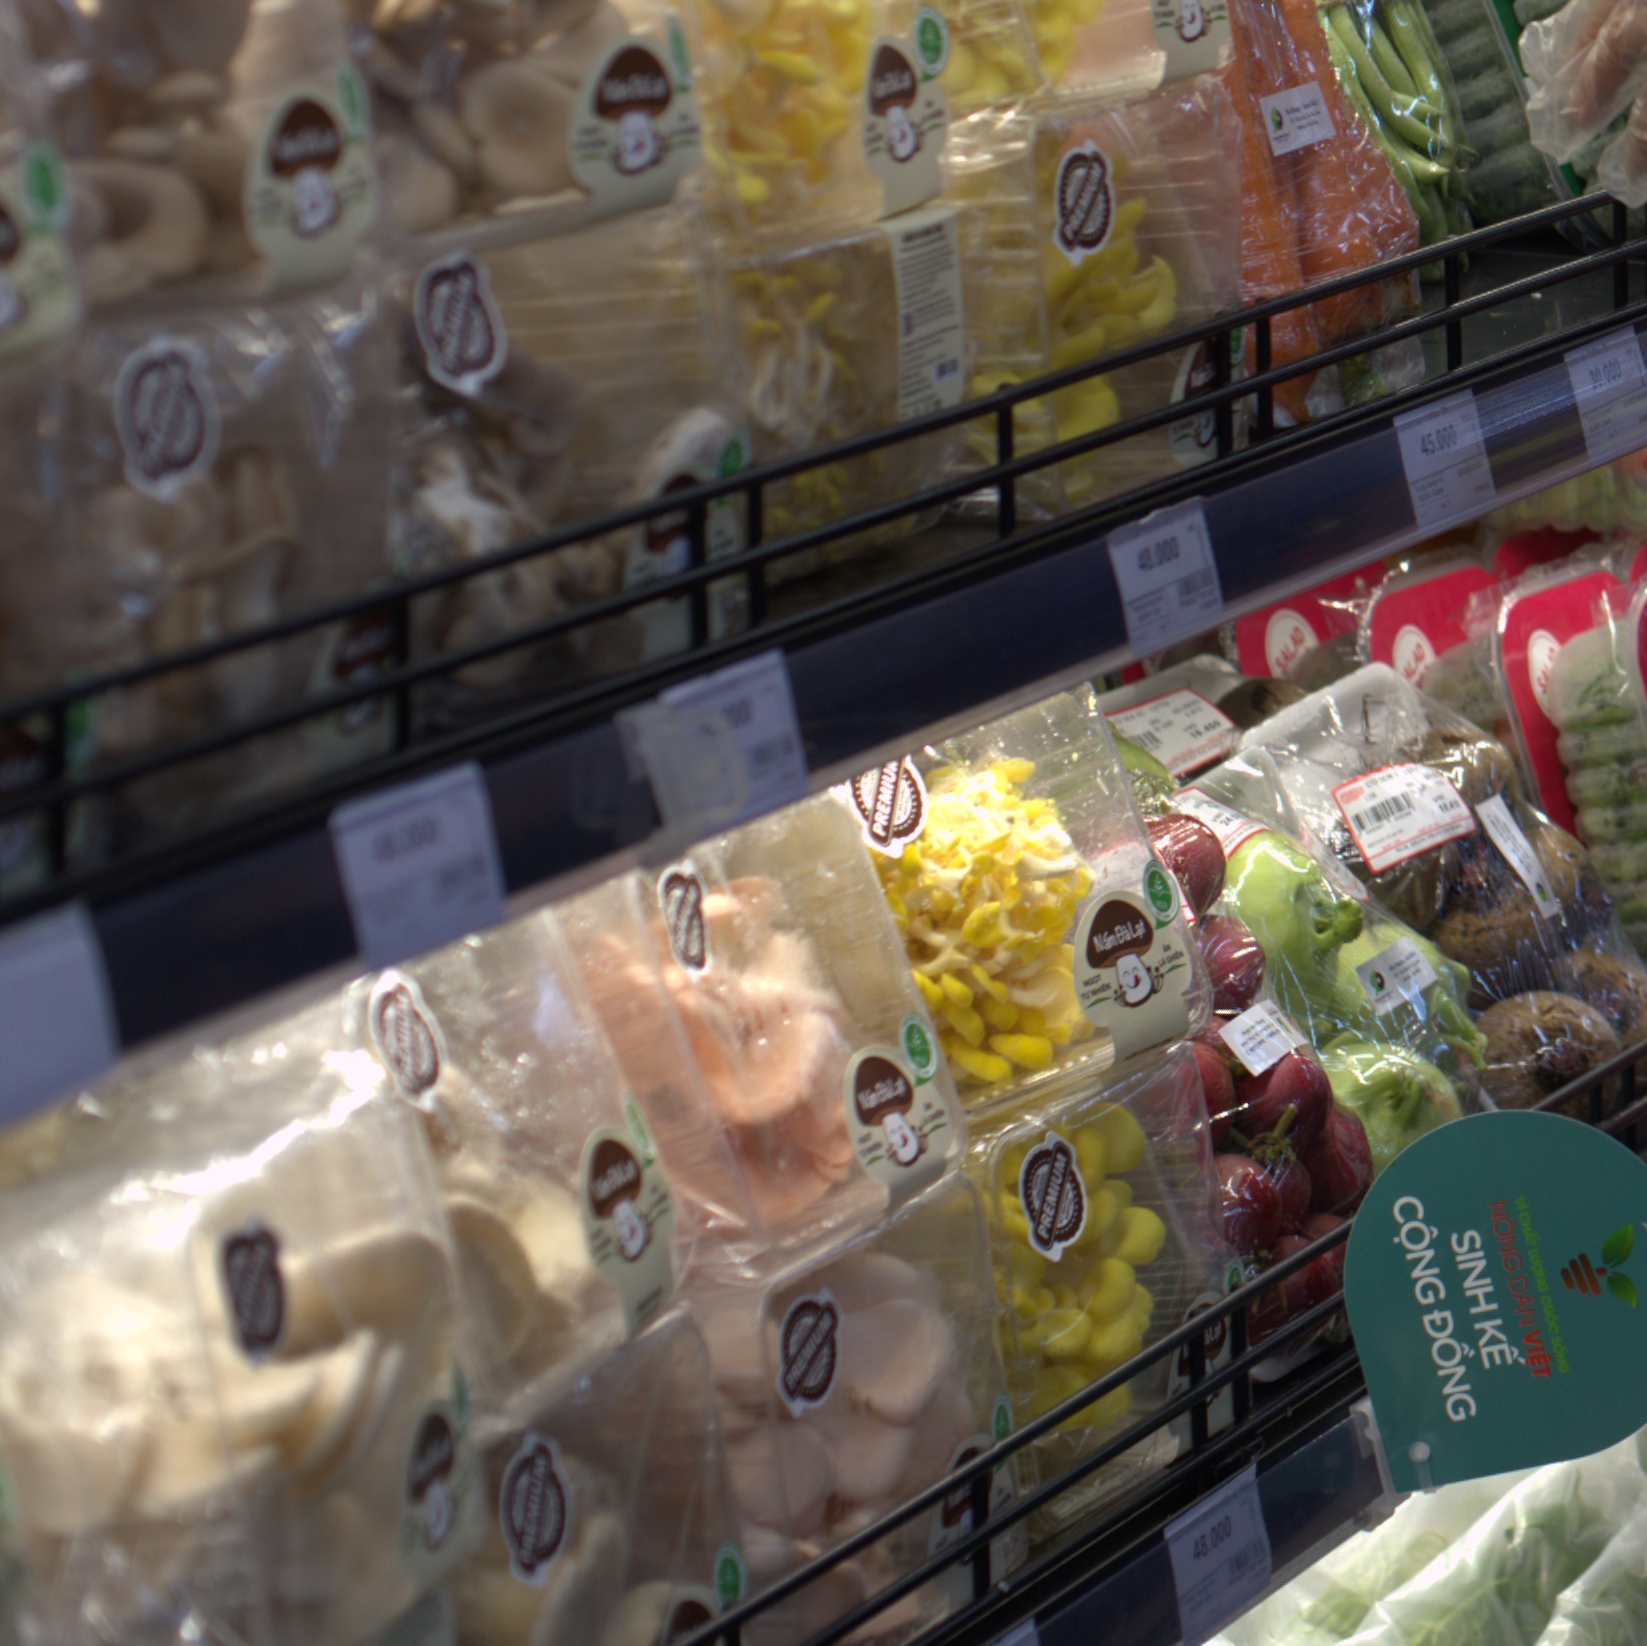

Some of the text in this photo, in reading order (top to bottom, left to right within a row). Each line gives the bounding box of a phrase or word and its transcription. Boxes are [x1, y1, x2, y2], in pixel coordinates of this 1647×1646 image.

[1420, 424, 1458, 455] 45.000
[1137, 535, 1181, 571] 48.000
[1274, 626, 1306, 673] SALAD
[1037, 1151, 1067, 1239] PREMIUM
[1519, 1211, 1541, 1245] CHẤT
[1488, 1199, 1553, 1378] NÔNG DÂN VIỆT
[1528, 1247, 1550, 1293] LƯỢNG
[1392, 1195, 1477, 1423] CỘNG ĐỒNG
[1451, 1229, 1529, 1370] SINH KẾ
[1540, 1294, 1562, 1335] CUỘC
[785, 1311, 835, 1392] PREMIUM
[1551, 1335, 1570, 1375] SỐNG
[1193, 1515, 1233, 1560] 48.000
